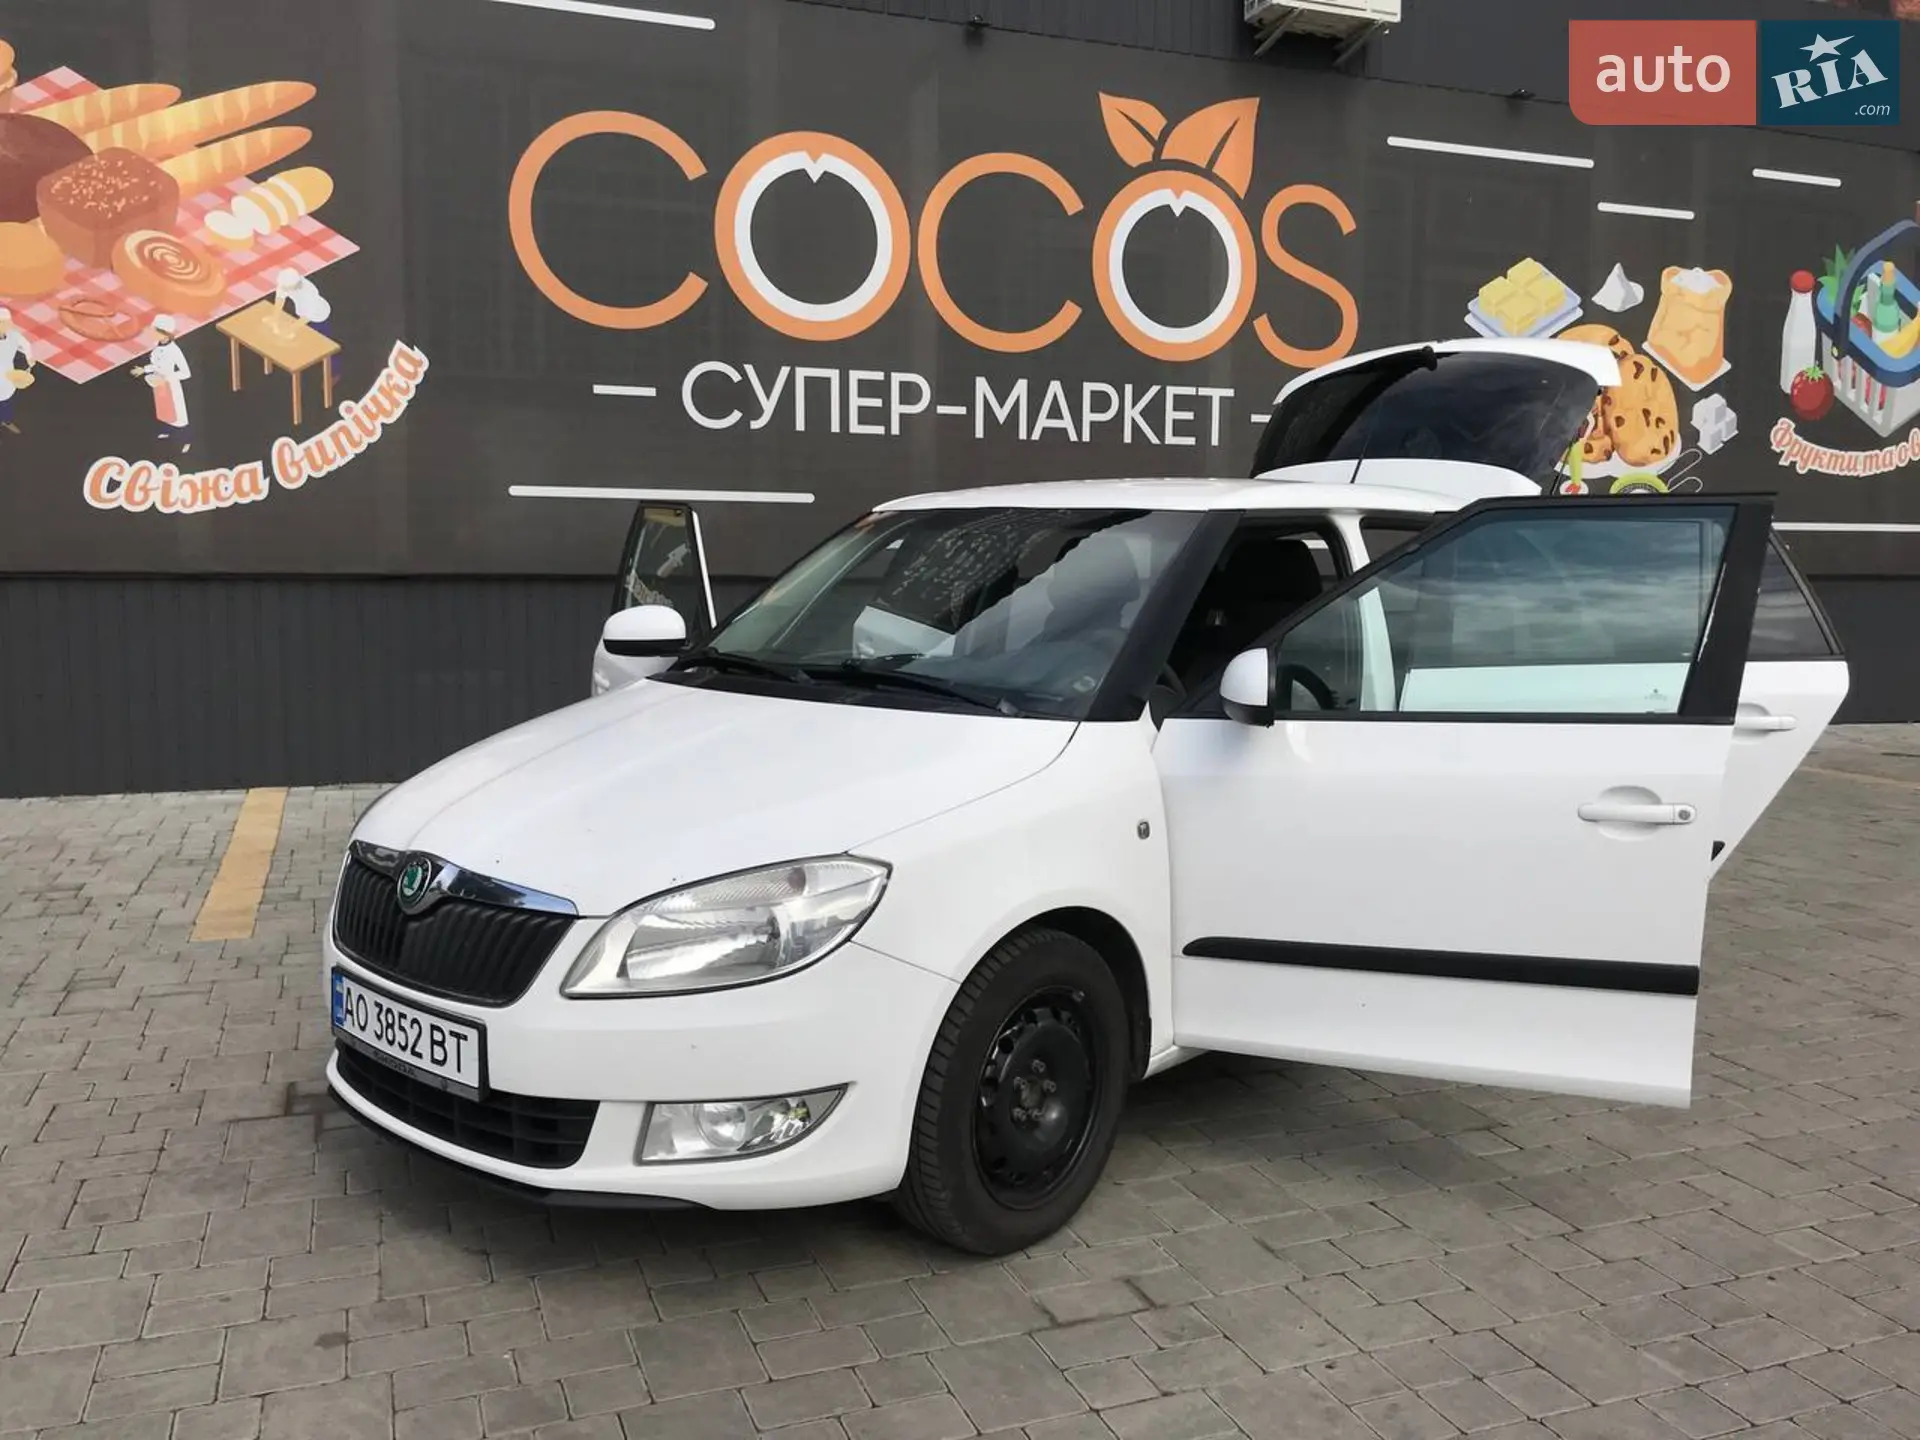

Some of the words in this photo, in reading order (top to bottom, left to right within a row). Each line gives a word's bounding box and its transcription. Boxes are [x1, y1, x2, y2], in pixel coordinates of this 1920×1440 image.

[508, 110, 1358, 368] COCOS
[85, 457, 268, 513] Свіжа
[272, 341, 428, 488] випічка
[681, 360, 1235, 446] СУПЕР-МАРКЕТ
[374, 1000, 423, 1059] 3852
[430, 1023, 468, 1073] BT
